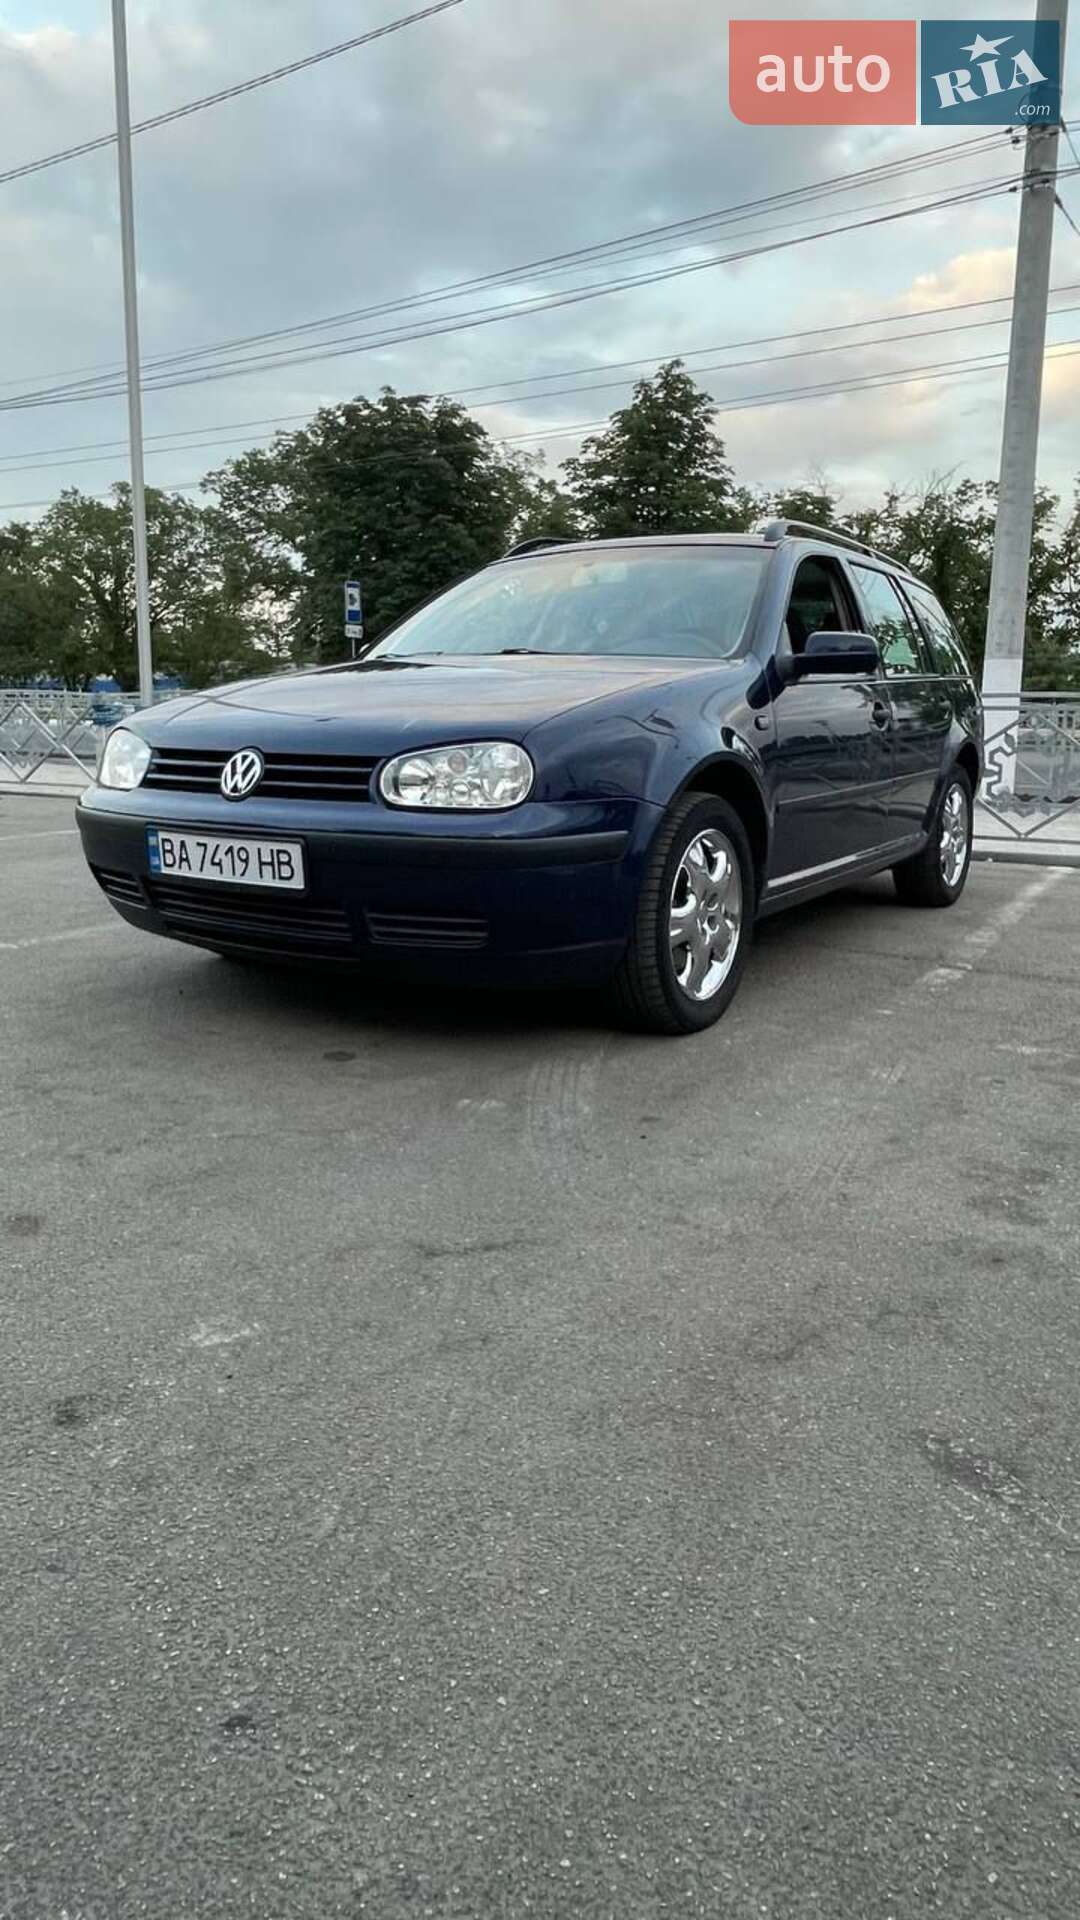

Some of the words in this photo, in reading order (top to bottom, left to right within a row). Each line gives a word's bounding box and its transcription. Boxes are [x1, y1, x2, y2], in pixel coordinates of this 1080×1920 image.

[161, 838, 192, 871] BA
[196, 842, 250, 877] 7419
[257, 847, 295, 881] HB
